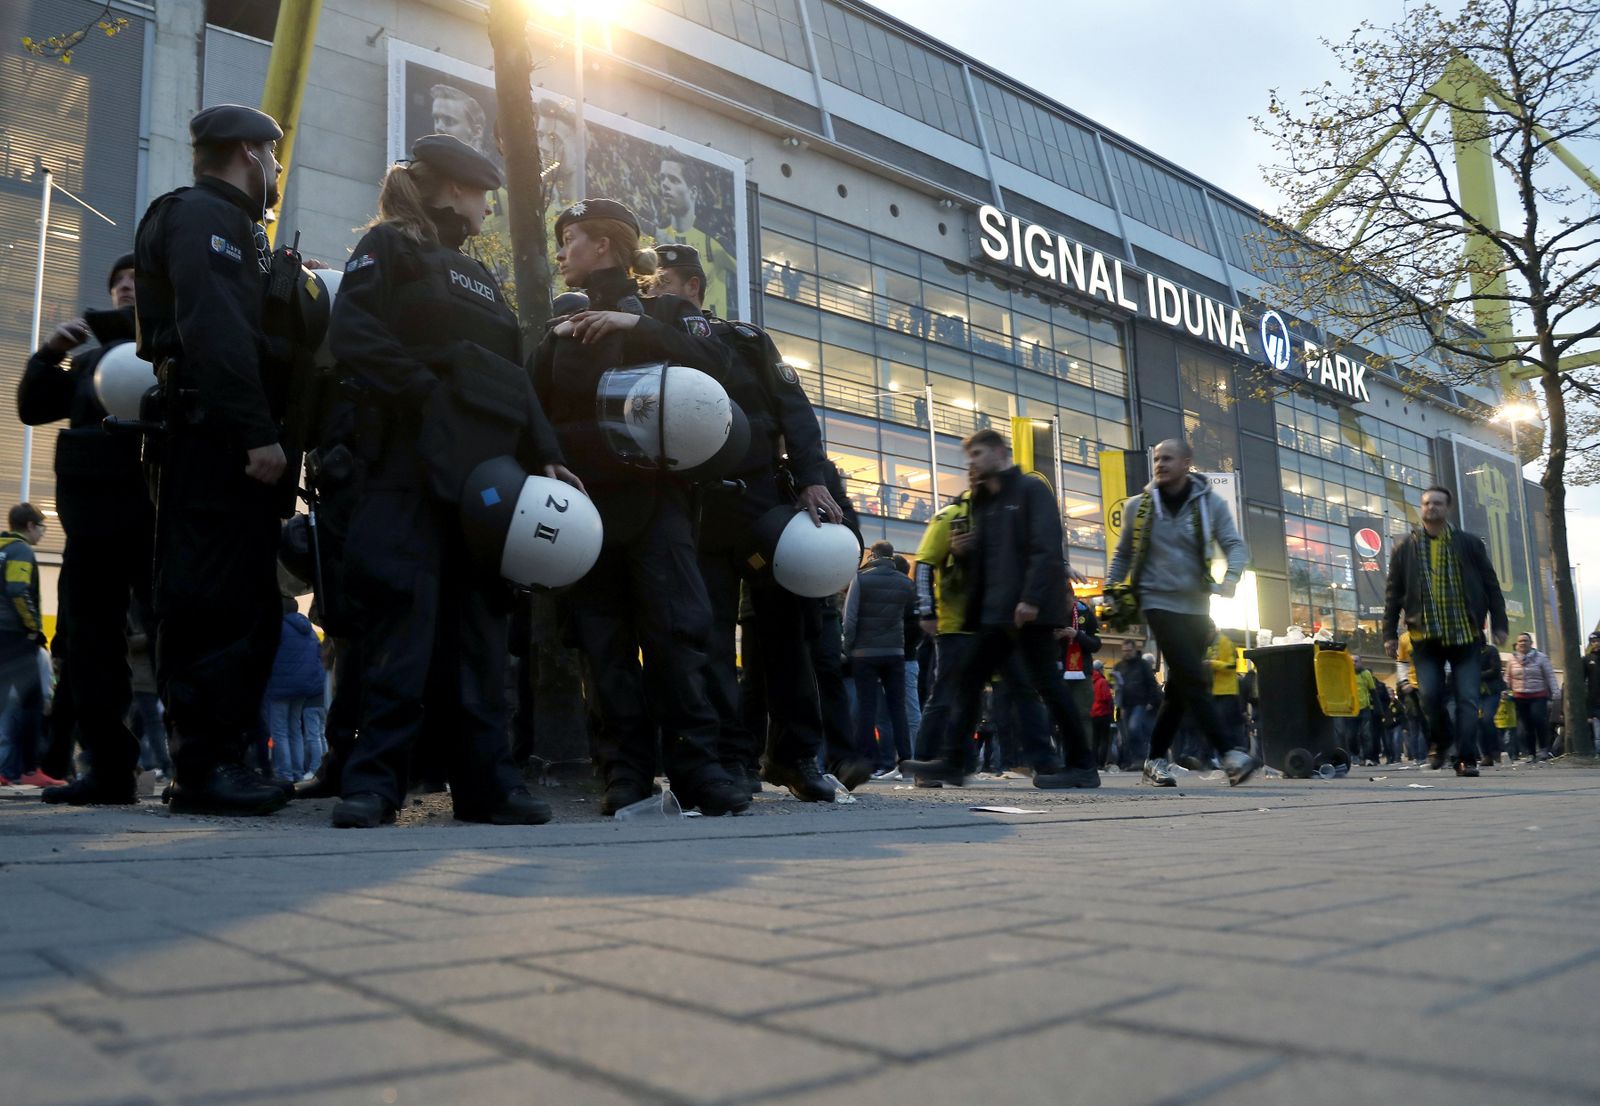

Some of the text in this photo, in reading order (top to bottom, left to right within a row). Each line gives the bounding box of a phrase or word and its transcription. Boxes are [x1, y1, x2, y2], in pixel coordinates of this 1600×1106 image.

[450, 269, 496, 302] POLIZEI
[979, 204, 1370, 402] SIGNAL IDUNA PARK
[545, 494, 569, 513] 2
